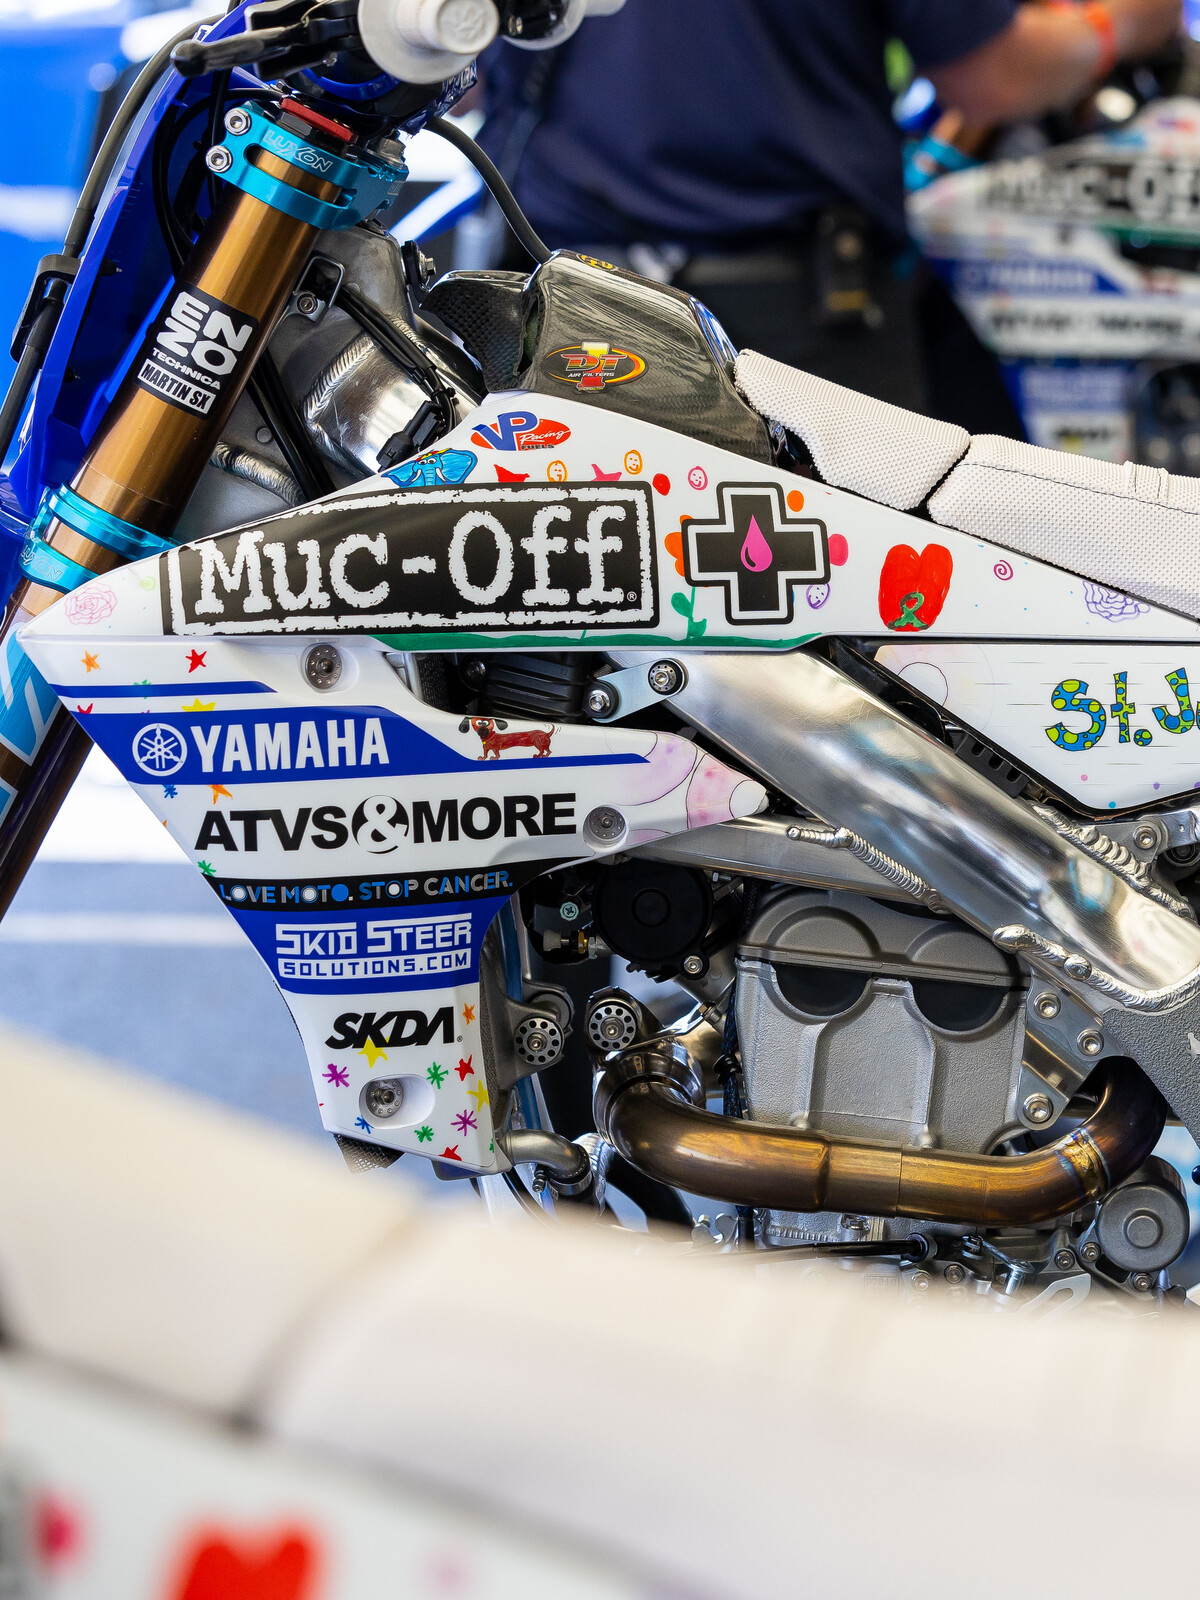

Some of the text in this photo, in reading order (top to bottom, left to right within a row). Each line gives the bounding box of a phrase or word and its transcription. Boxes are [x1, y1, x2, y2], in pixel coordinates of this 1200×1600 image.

[262, 129, 333, 172] LUXON
[140, 363, 211, 410] MARTIN SX
[151, 347, 221, 390] TECHNICA
[471, 411, 539, 451] VP
[519, 429, 571, 444] Racing
[194, 504, 627, 615] Muc-Off
[190, 717, 390, 773] YAMAHA
[193, 792, 577, 854] ATVS&MORE
[219, 870, 514, 904] LOVE MOTO. STOP CANCER.
[275, 912, 472, 956] SKID STEER
[283, 951, 468, 977] SOLUTIONS.COM
[324, 1005, 455, 1049] SKDA
